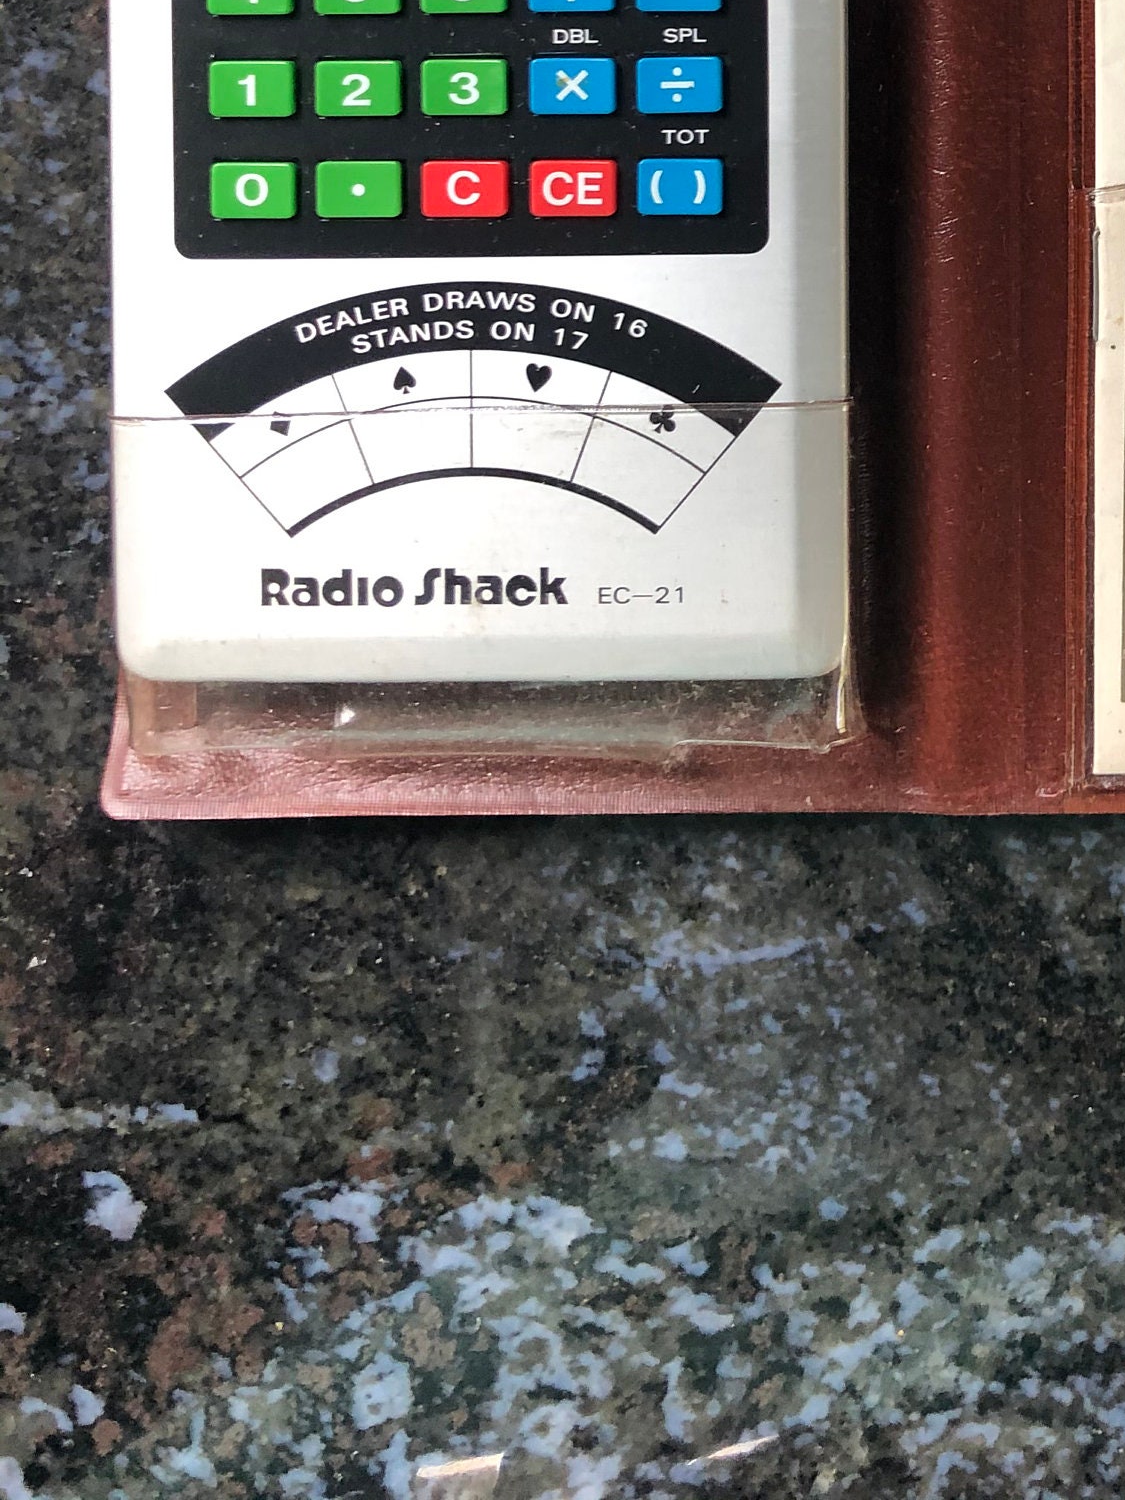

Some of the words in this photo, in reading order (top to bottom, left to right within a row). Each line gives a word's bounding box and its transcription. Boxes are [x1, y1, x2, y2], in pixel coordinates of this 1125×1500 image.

[552, 29, 599, 44] DBL
[663, 28, 707, 43] SPL
[238, 74, 256, 106] 1
[342, 74, 371, 106] 2
[449, 72, 480, 105] 3
[661, 129, 710, 144] TOT
[446, 172, 481, 205] C
[541, 172, 604, 205] CE
[295, 296, 410, 344] DEALER
[423, 291, 536, 312] DRAWS
[551, 299, 595, 322] ON
[614, 313, 648, 338] 16
[351, 321, 475, 354] STANDS
[490, 321, 535, 341] ON
[554, 328, 589, 349] 17
[261, 568, 404, 607] Radio
[415, 567, 568, 607] Shack
